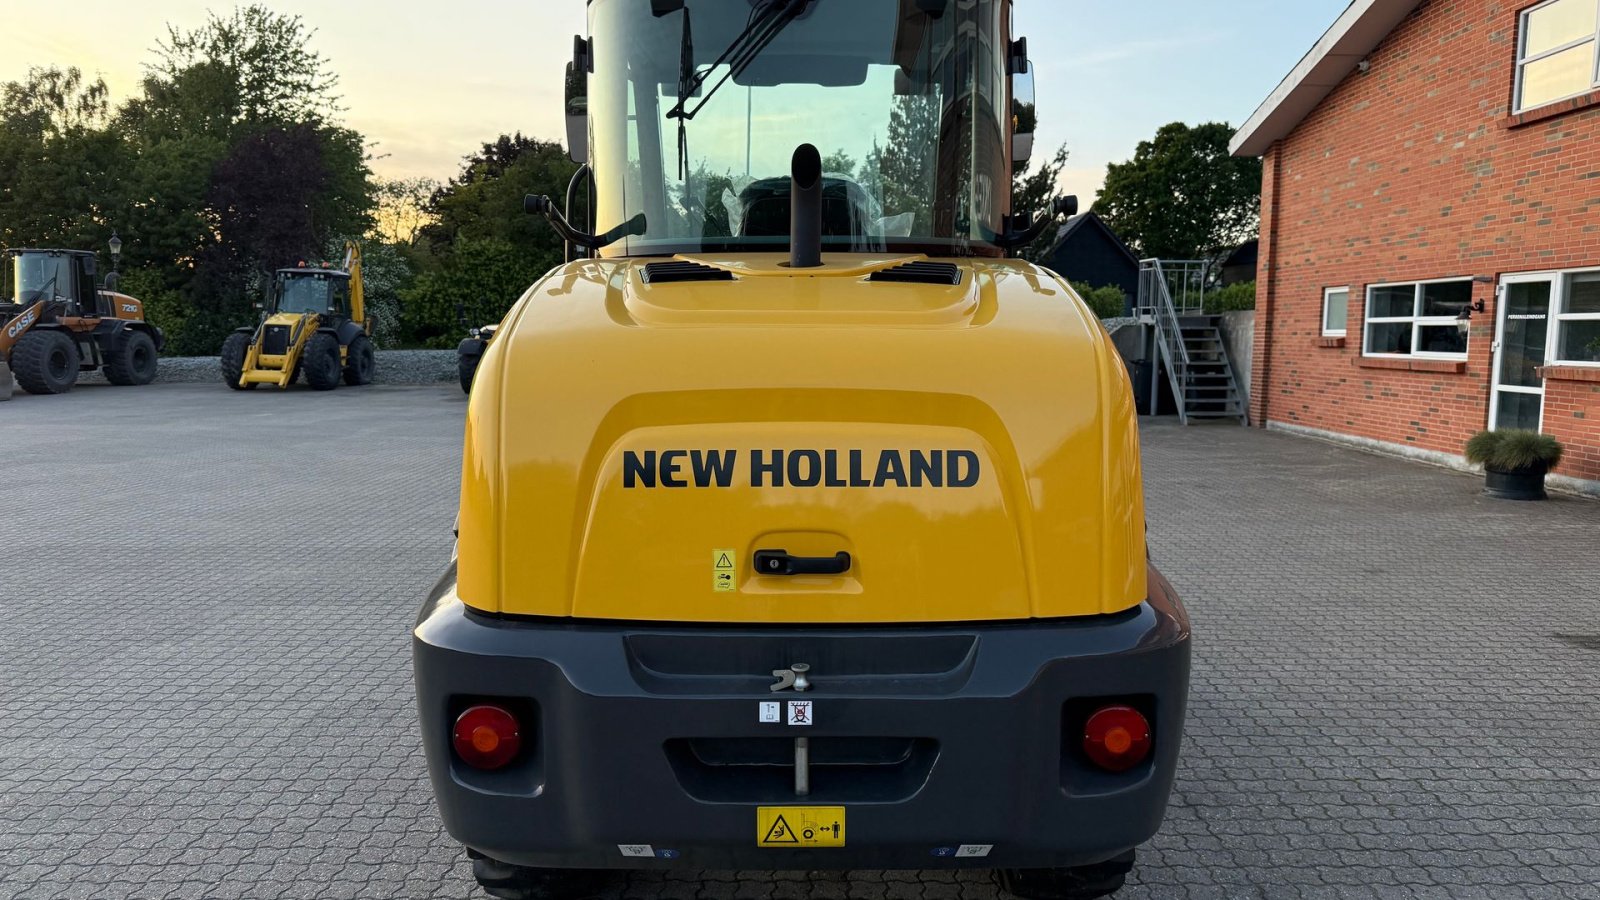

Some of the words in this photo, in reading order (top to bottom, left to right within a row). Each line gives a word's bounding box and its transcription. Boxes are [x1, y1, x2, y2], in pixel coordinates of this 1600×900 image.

[8, 311, 35, 338] CASE
[623, 450, 737, 489] NEW
[750, 449, 980, 488] HOLLAND
